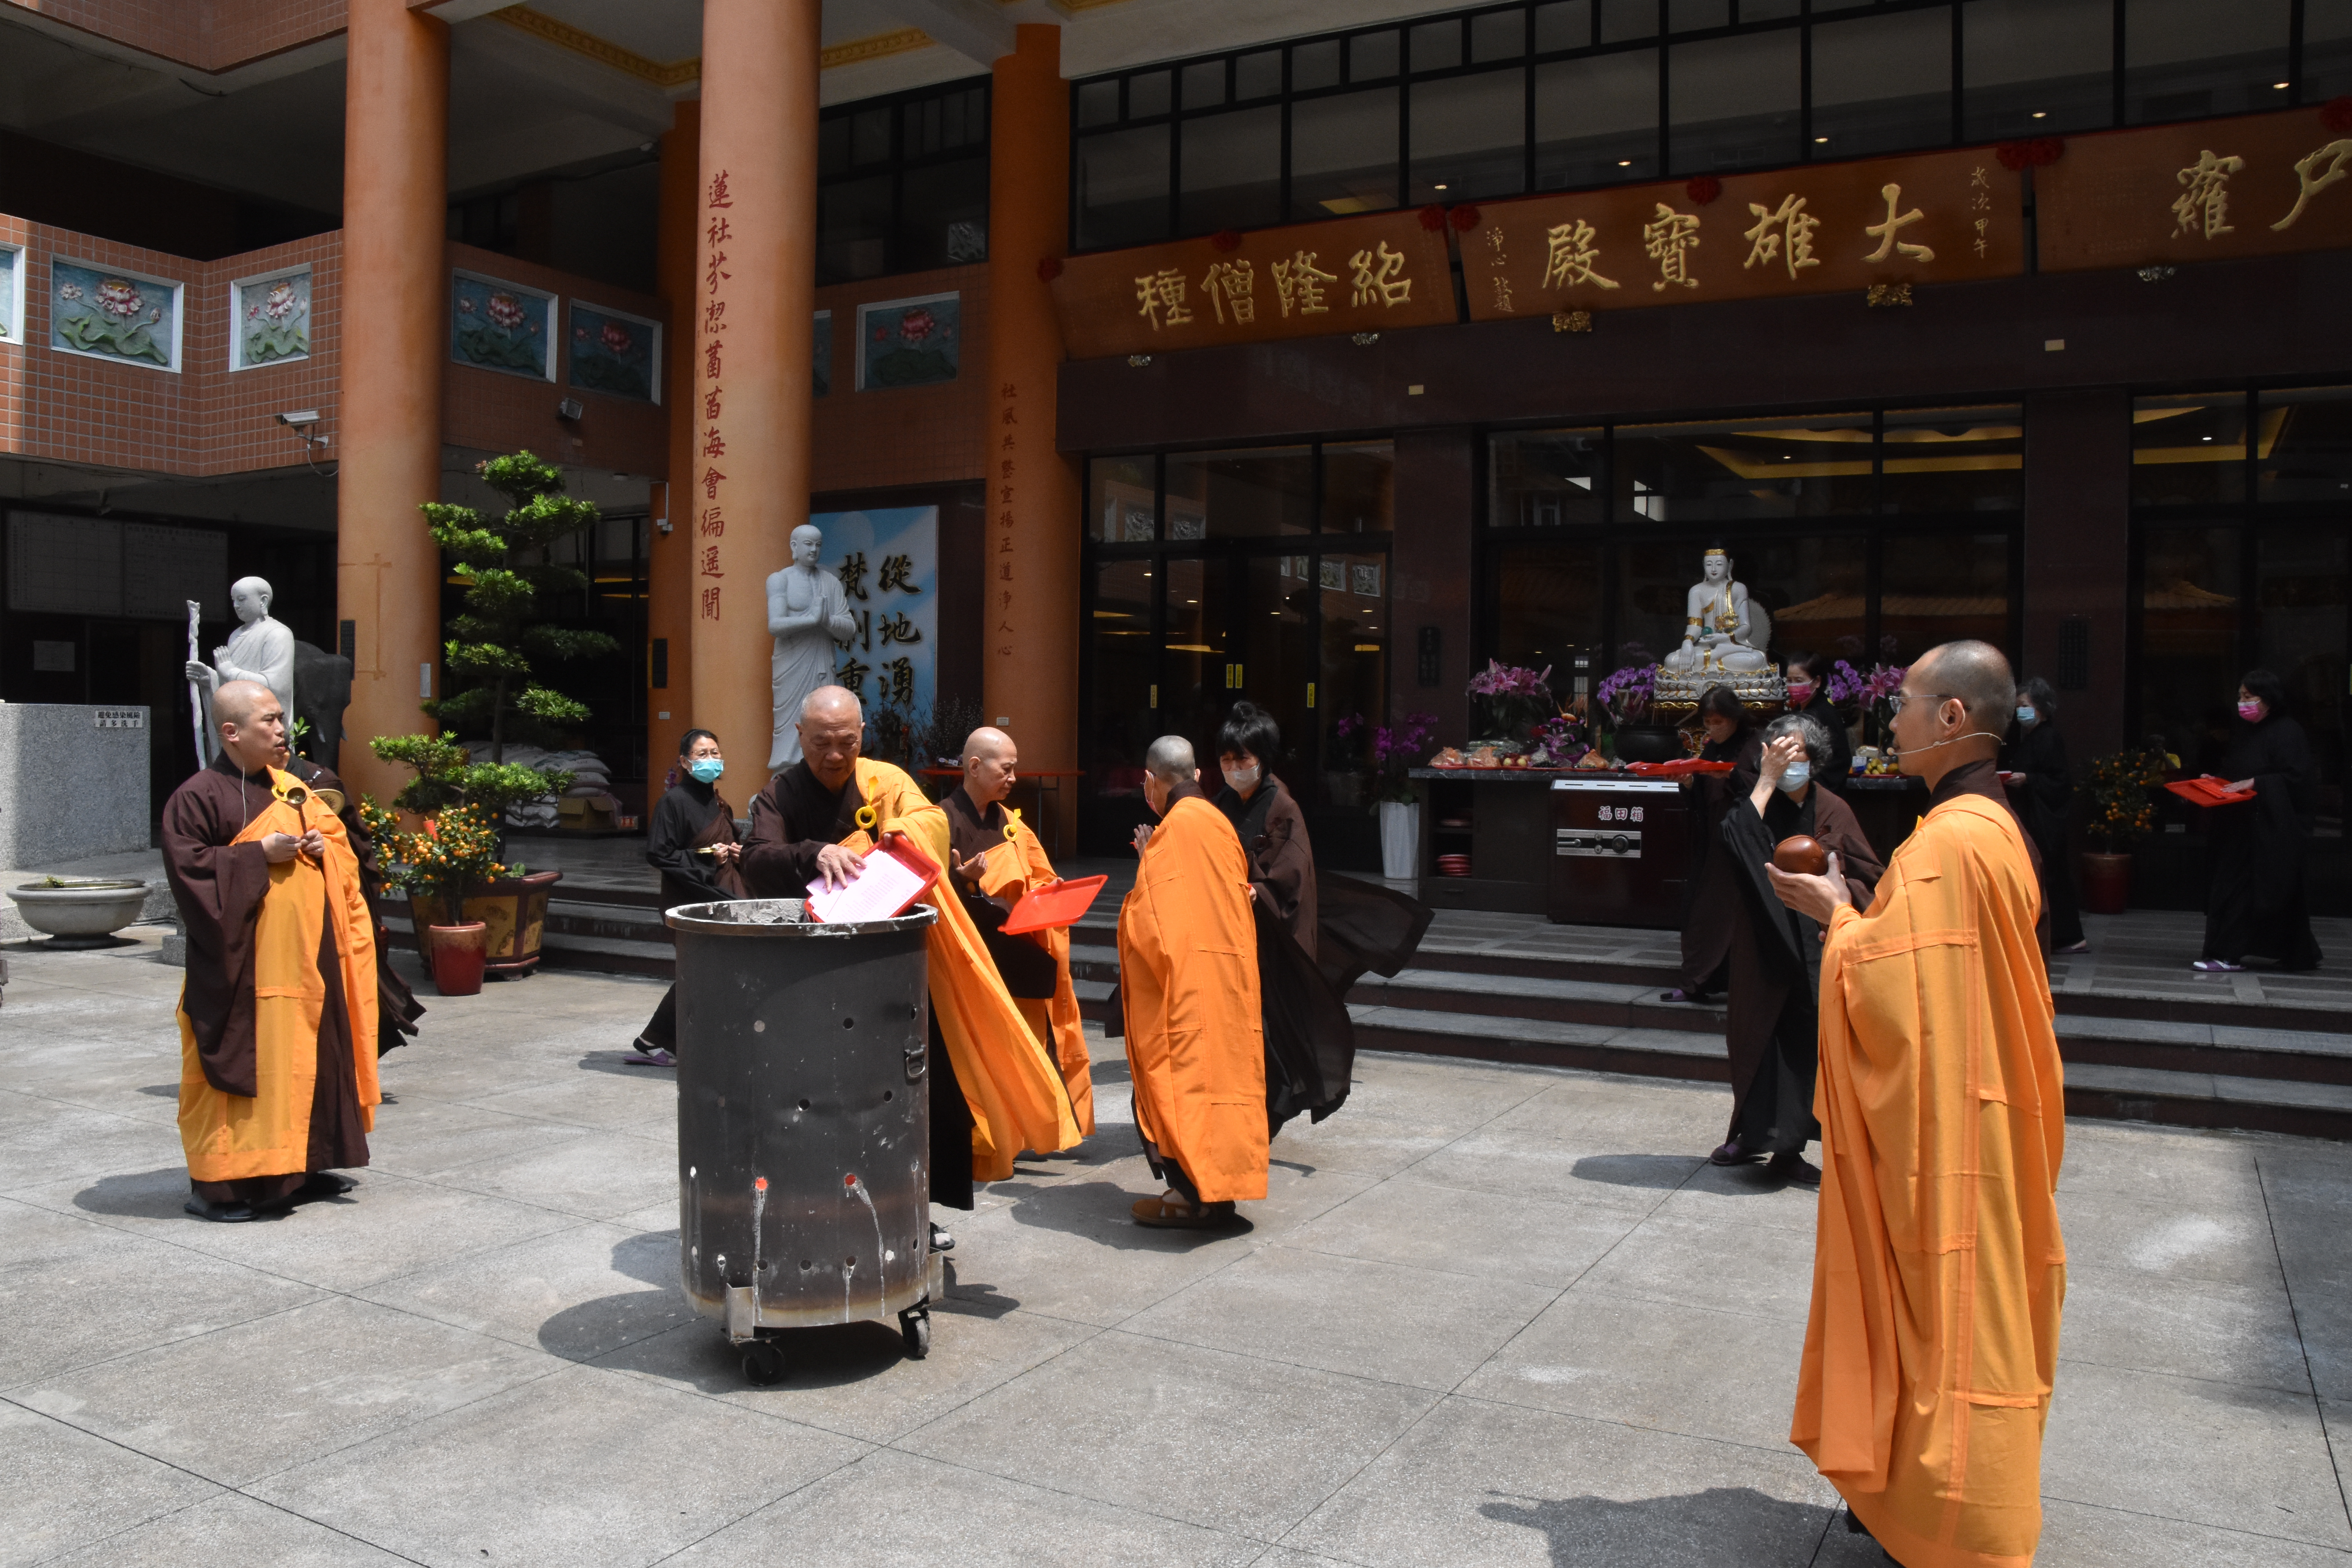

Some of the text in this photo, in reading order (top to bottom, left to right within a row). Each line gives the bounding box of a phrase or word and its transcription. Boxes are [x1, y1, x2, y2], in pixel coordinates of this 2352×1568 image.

[1542, 183, 1935, 292] 大雄寶殿
[1134, 240, 1411, 331] 紹隆僧種
[1598, 806, 1644, 822] 福田箱
